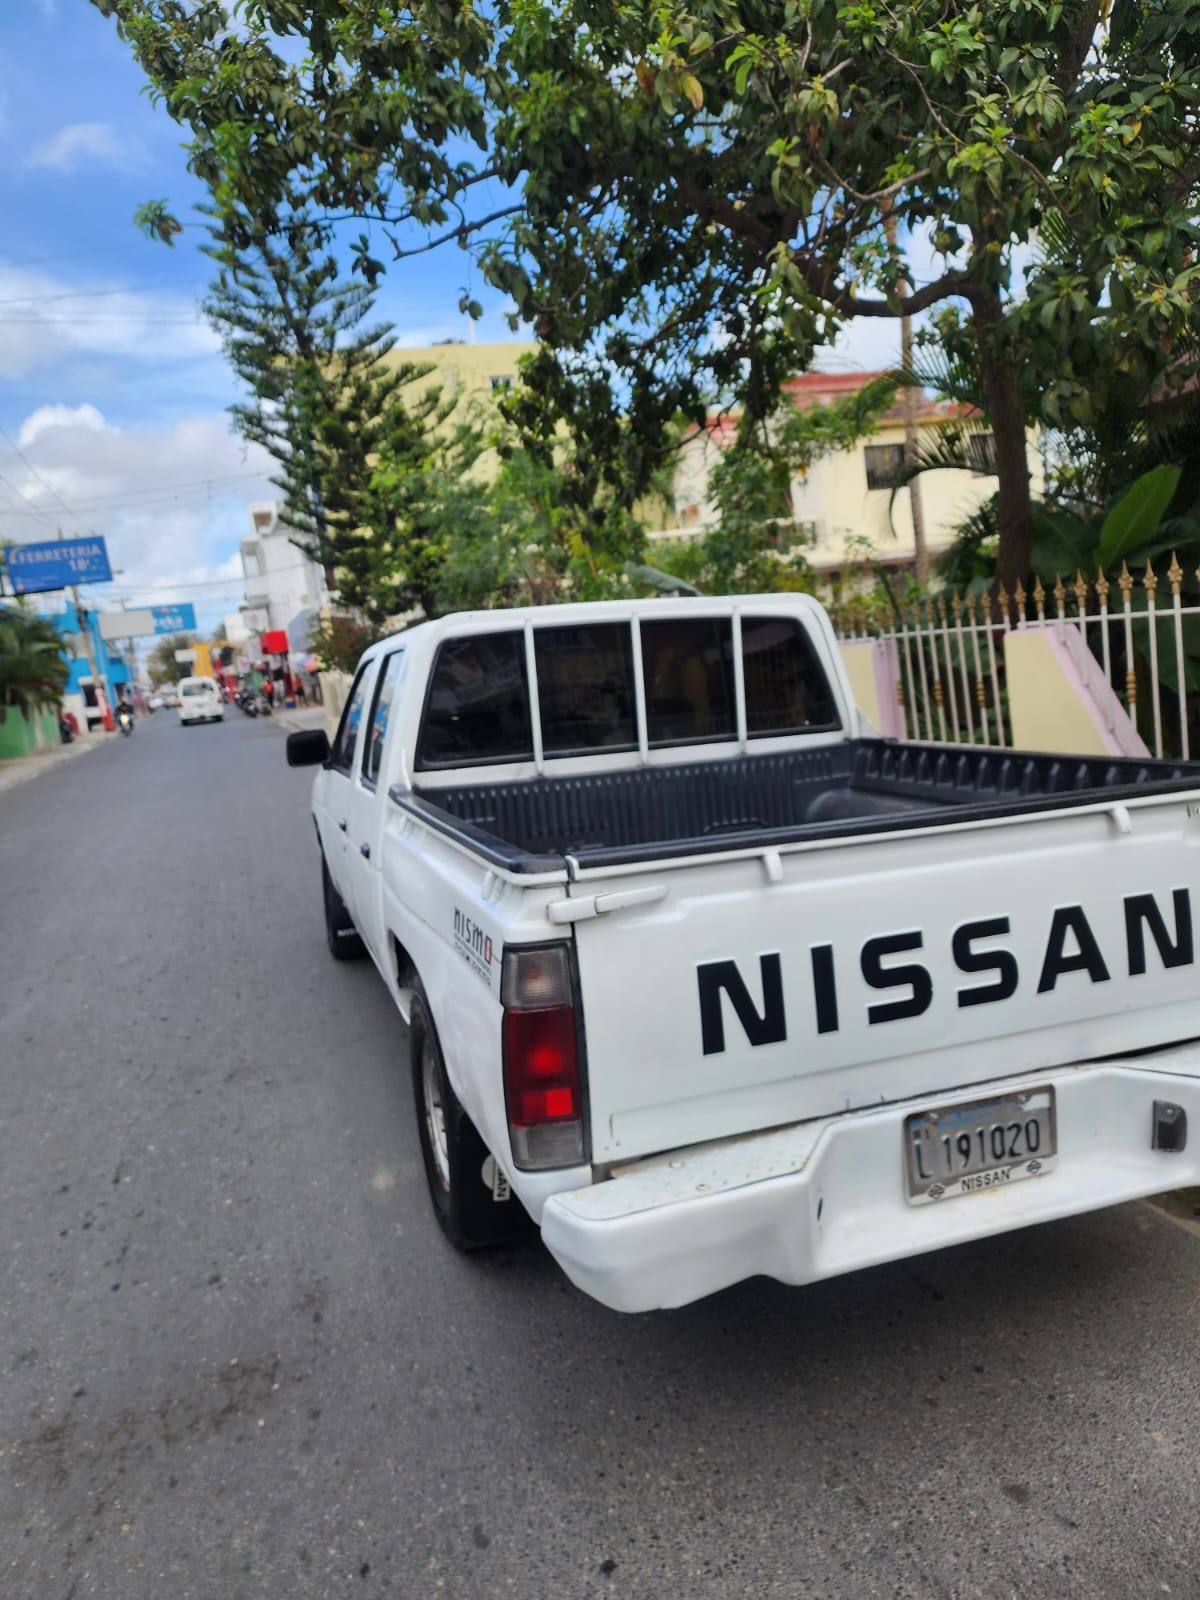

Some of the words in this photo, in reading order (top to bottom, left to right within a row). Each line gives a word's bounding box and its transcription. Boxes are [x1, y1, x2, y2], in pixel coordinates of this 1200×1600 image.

[18, 543, 102, 565] FERRETERIA
[696, 887, 1195, 1056] NISSAN
[961, 1168, 1011, 1192] NISSAN
